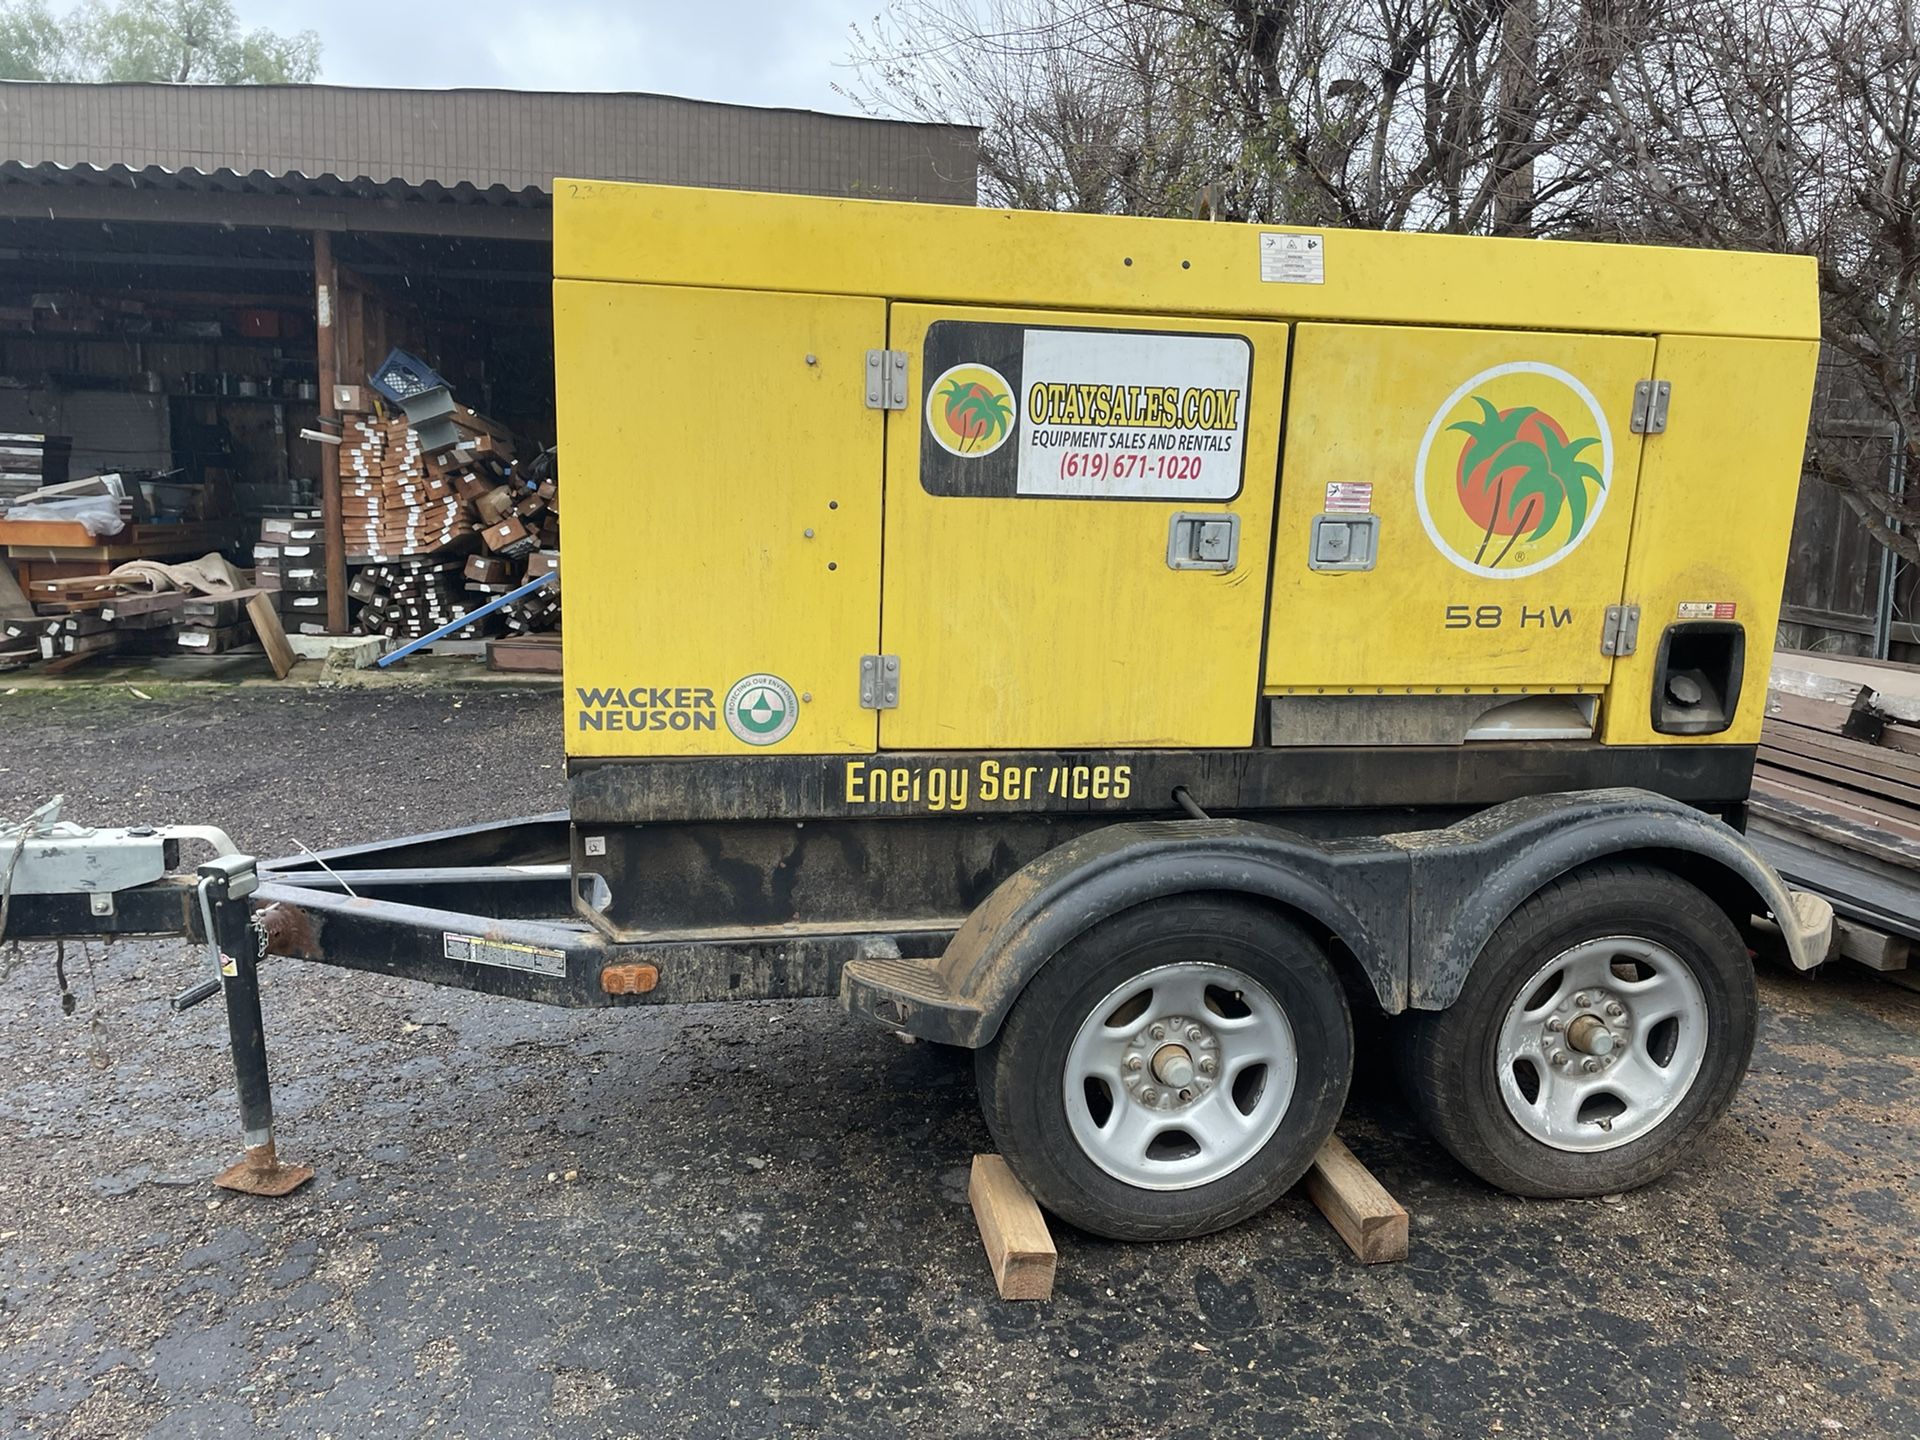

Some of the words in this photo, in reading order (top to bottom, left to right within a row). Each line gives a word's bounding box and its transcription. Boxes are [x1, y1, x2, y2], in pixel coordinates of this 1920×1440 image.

[1028, 381, 1240, 431] OTAYSALES.COM
[1031, 430, 1108, 449] EQUIPMENT
[1108, 433, 1146, 450] SALES
[1148, 433, 1176, 451] AND
[1178, 434, 1232, 452] RENTALS
[1060, 451, 1108, 481] (619)
[1113, 454, 1202, 481] 671-1020
[1445, 605, 1503, 629] 58
[576, 687, 717, 708] WACKER
[579, 711, 717, 731] NEUSON
